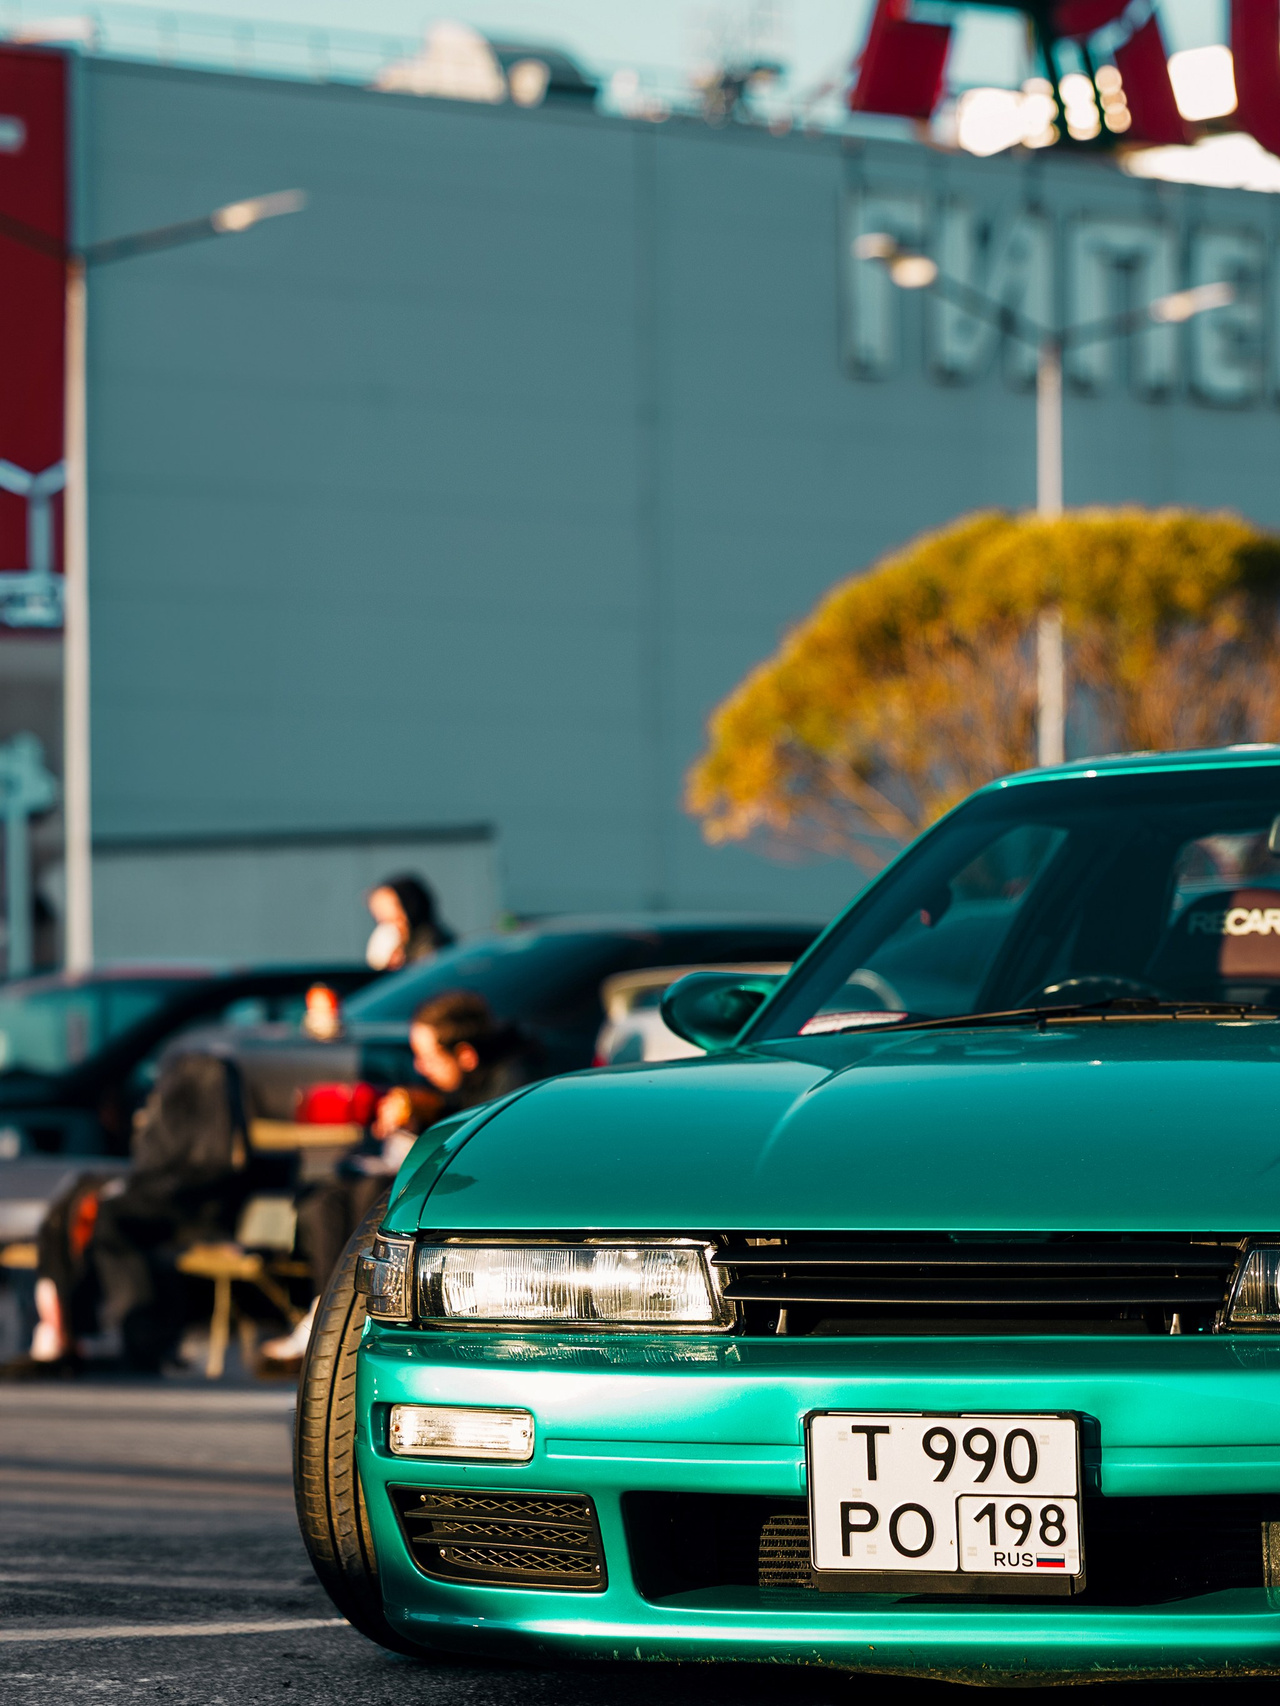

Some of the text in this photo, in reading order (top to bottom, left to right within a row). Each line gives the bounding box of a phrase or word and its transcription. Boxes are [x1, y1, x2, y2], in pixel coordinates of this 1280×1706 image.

[922, 1426, 1038, 1484] 990
[973, 1502, 1067, 1547] 198
[994, 1551, 1034, 1567] RUS
